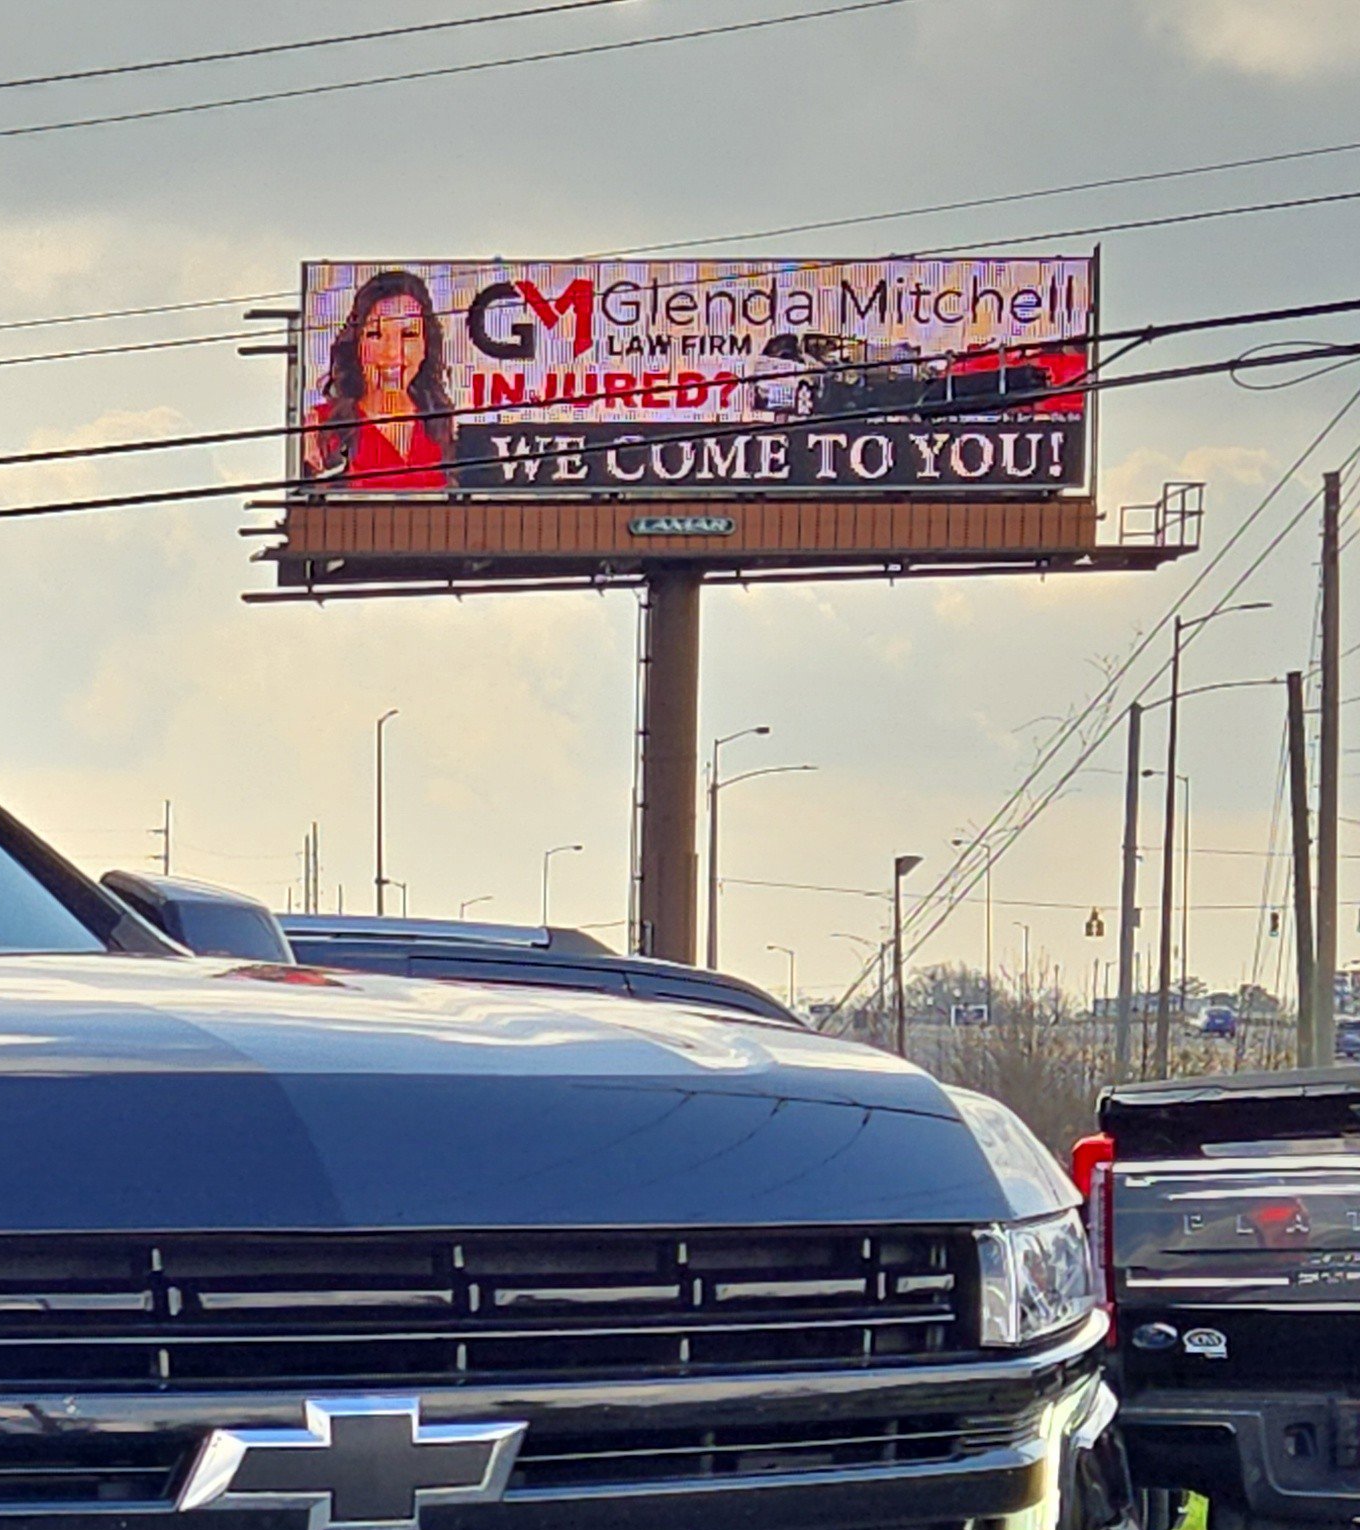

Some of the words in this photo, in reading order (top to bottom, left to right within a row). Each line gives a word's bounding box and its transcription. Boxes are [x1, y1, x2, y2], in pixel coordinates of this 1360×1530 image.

[466, 278, 595, 359] GM
[601, 276, 813, 326] Glenda
[840, 274, 1074, 324] Mitchell
[607, 334, 671, 356] LAW
[682, 333, 752, 356] FIRM
[472, 371, 740, 410] INJURED?
[490, 435, 590, 482] WE
[606, 434, 792, 481] COME
[807, 432, 894, 480] TO
[908, 431, 1066, 479] YOU!
